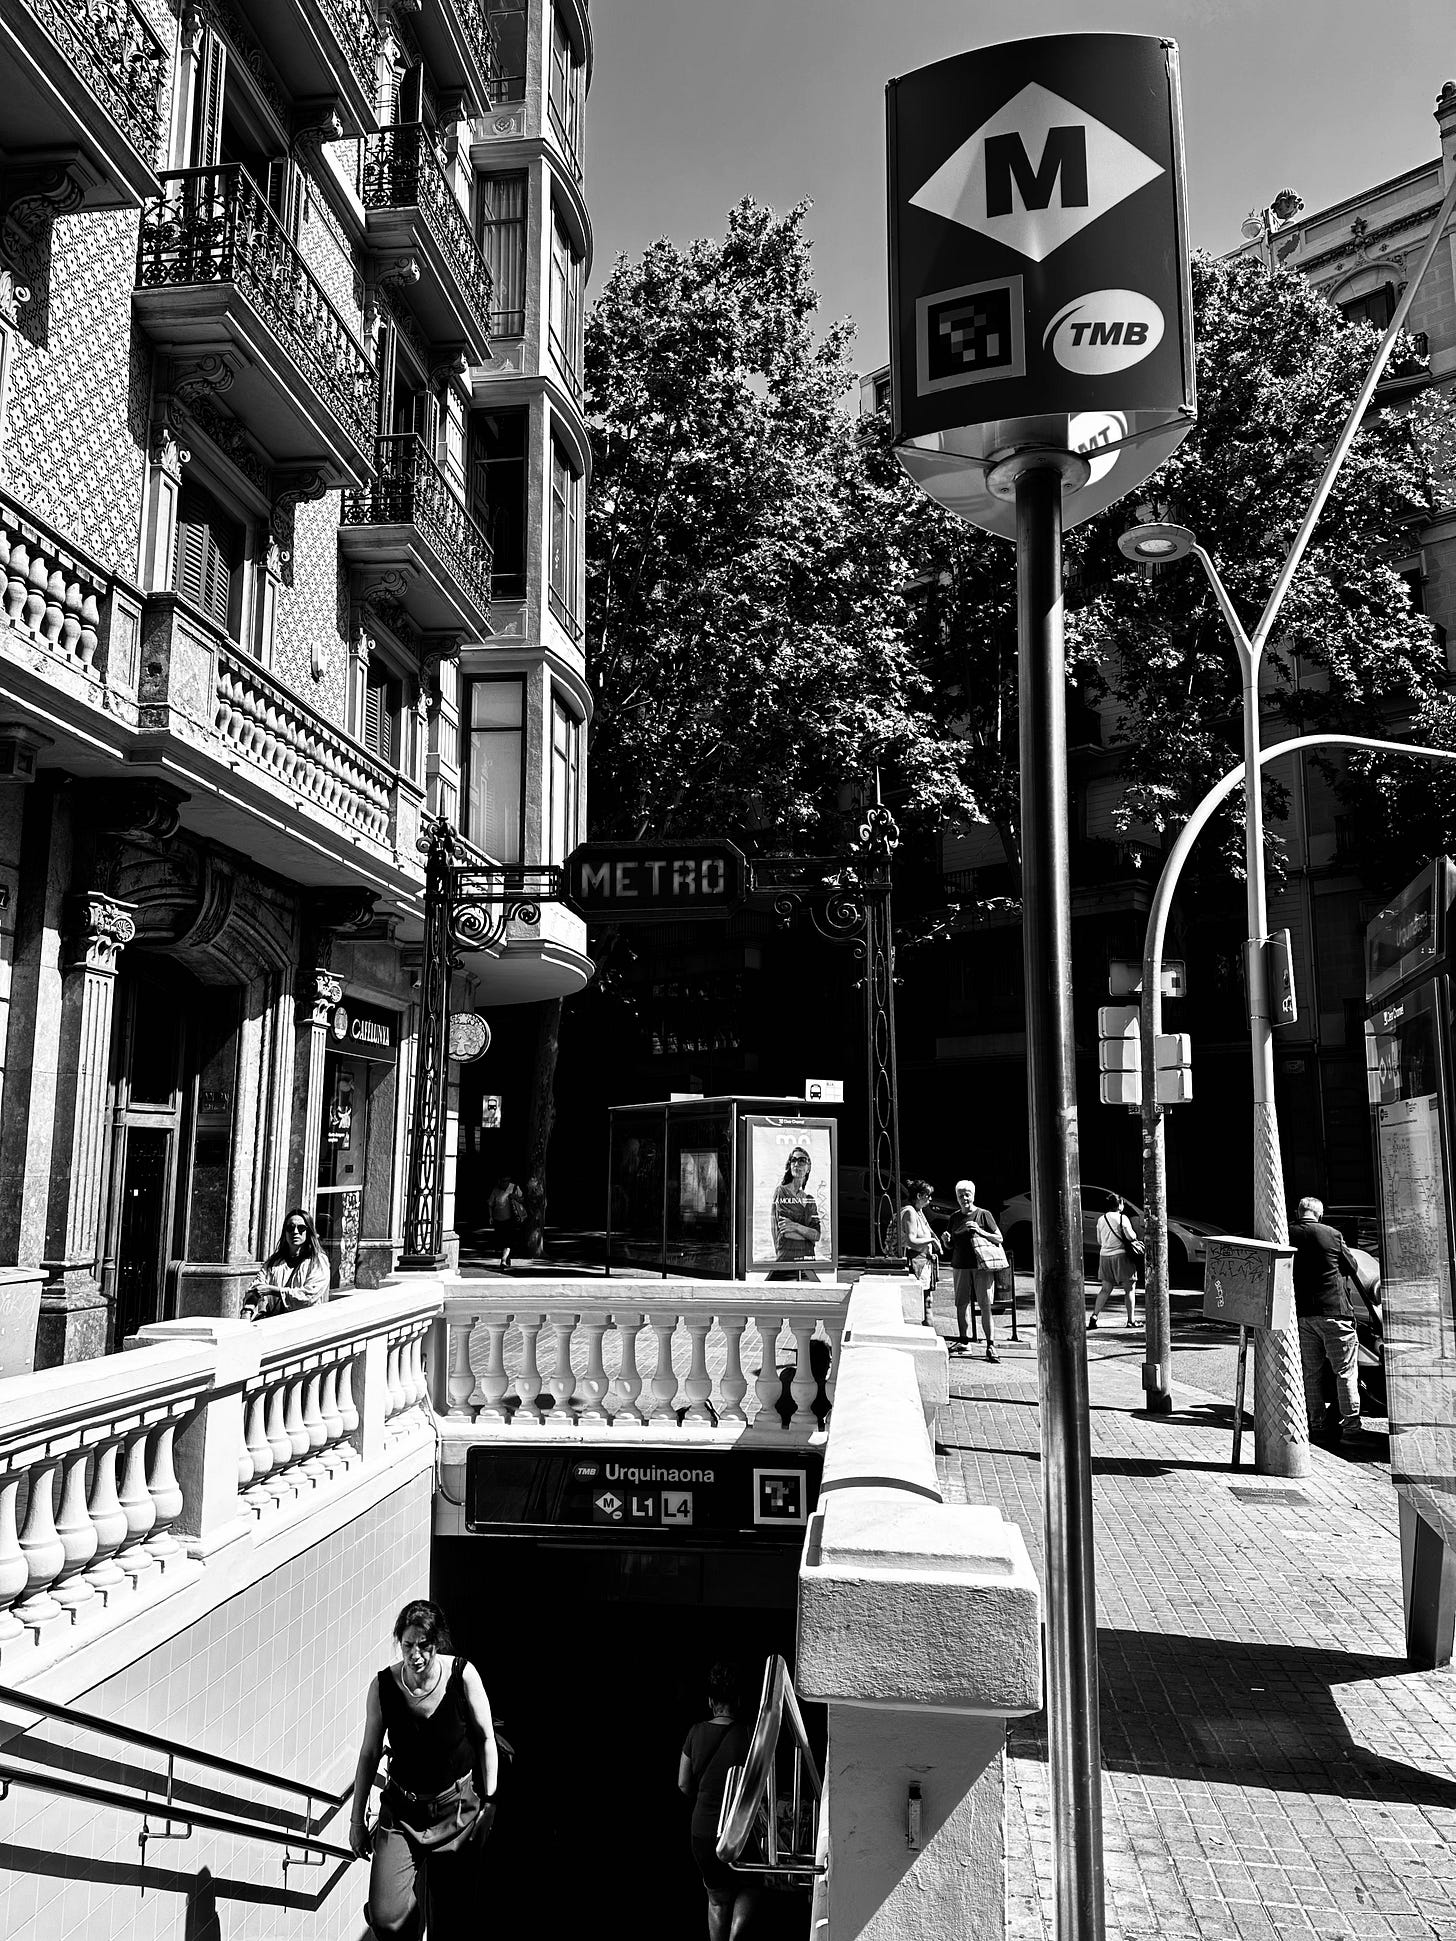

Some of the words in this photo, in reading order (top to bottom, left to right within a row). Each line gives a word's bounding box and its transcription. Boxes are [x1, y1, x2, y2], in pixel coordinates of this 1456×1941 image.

[985, 125, 1089, 218] M
[1070, 322, 1149, 346] TMB
[581, 859, 724, 897] METRO
[577, 1467, 596, 1476] TMB
[605, 1463, 714, 1484] Urquinaona
[603, 1498, 614, 1509] M
[632, 1496, 653, 1517] L1
[663, 1497, 690, 1518] L4
